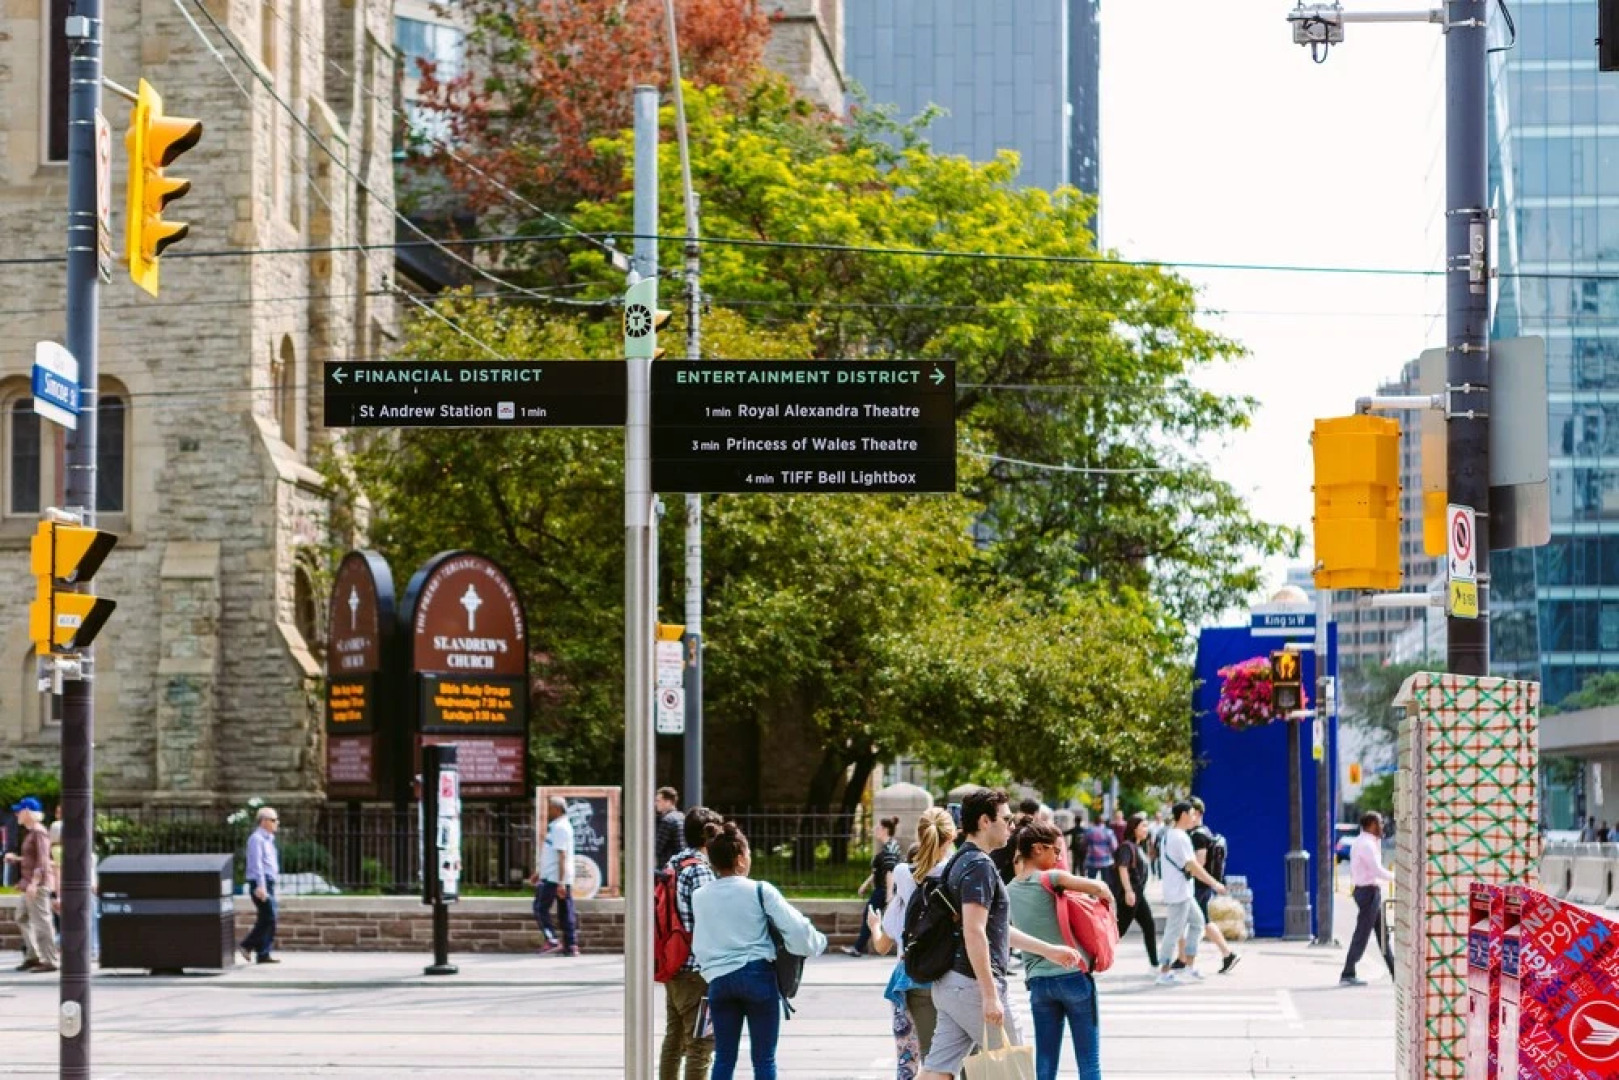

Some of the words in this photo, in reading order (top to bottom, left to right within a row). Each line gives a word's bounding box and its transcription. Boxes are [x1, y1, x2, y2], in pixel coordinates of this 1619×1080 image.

[354, 369, 453, 382] FINANCIAL
[459, 369, 543, 382] DISTRICT
[676, 370, 831, 383] ENTERTAINMENT
[836, 370, 921, 383] DISTRICT
[360, 404, 375, 417] St
[379, 404, 436, 417] Andrew
[440, 404, 493, 417] Station
[520, 407, 526, 417] 1
[527, 407, 547, 417] min
[705, 407, 710, 417] 1
[711, 407, 731, 417] min
[737, 404, 780, 419] Royal
[784, 404, 859, 417] Alexandra
[863, 404, 921, 417] Theatre
[692, 440, 699, 451] 3
[700, 440, 720, 450] min
[726, 437, 788, 451] Princess
[791, 436, 807, 451] of
[812, 437, 857, 451] Wales
[861, 437, 918, 451] Theatre
[745, 473, 754, 484] 4
[755, 473, 775, 484] min
[781, 470, 814, 483] TIFF
[818, 470, 846, 484] Bell
[850, 470, 916, 487] Lightbox
[1264, 613, 1286, 628] King
[1296, 613, 1306, 626] W
[446, 653, 495, 669] CHURCH
[1538, 910, 1590, 956] P9A
[1520, 942, 1558, 979] H9X
